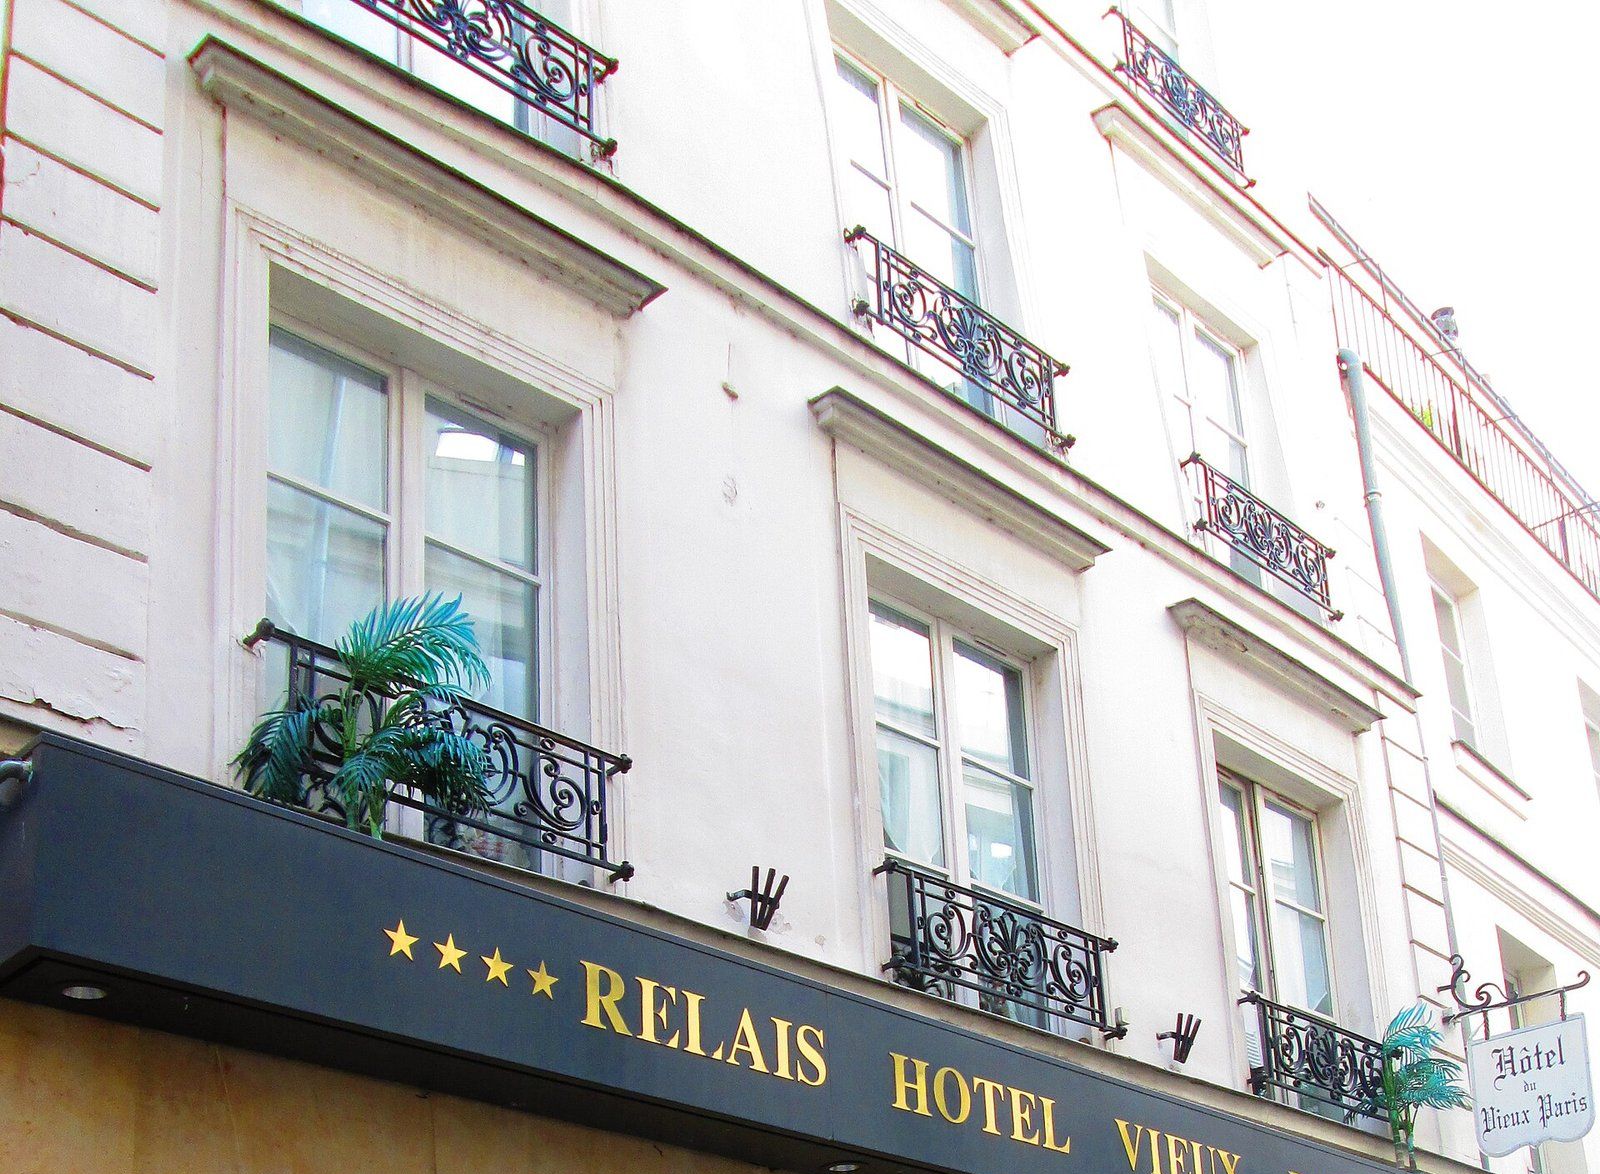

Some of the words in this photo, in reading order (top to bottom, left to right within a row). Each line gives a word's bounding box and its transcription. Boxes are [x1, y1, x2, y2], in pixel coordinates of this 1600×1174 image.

[579, 959, 828, 1087] RELAIS
[889, 1052, 1071, 1154] HOTEL
[1491, 1034, 1566, 1091] Hôtel
[1523, 1081, 1537, 1093] du
[1480, 1105, 1532, 1141] Vieux
[1537, 1092, 1588, 1129] Paris
